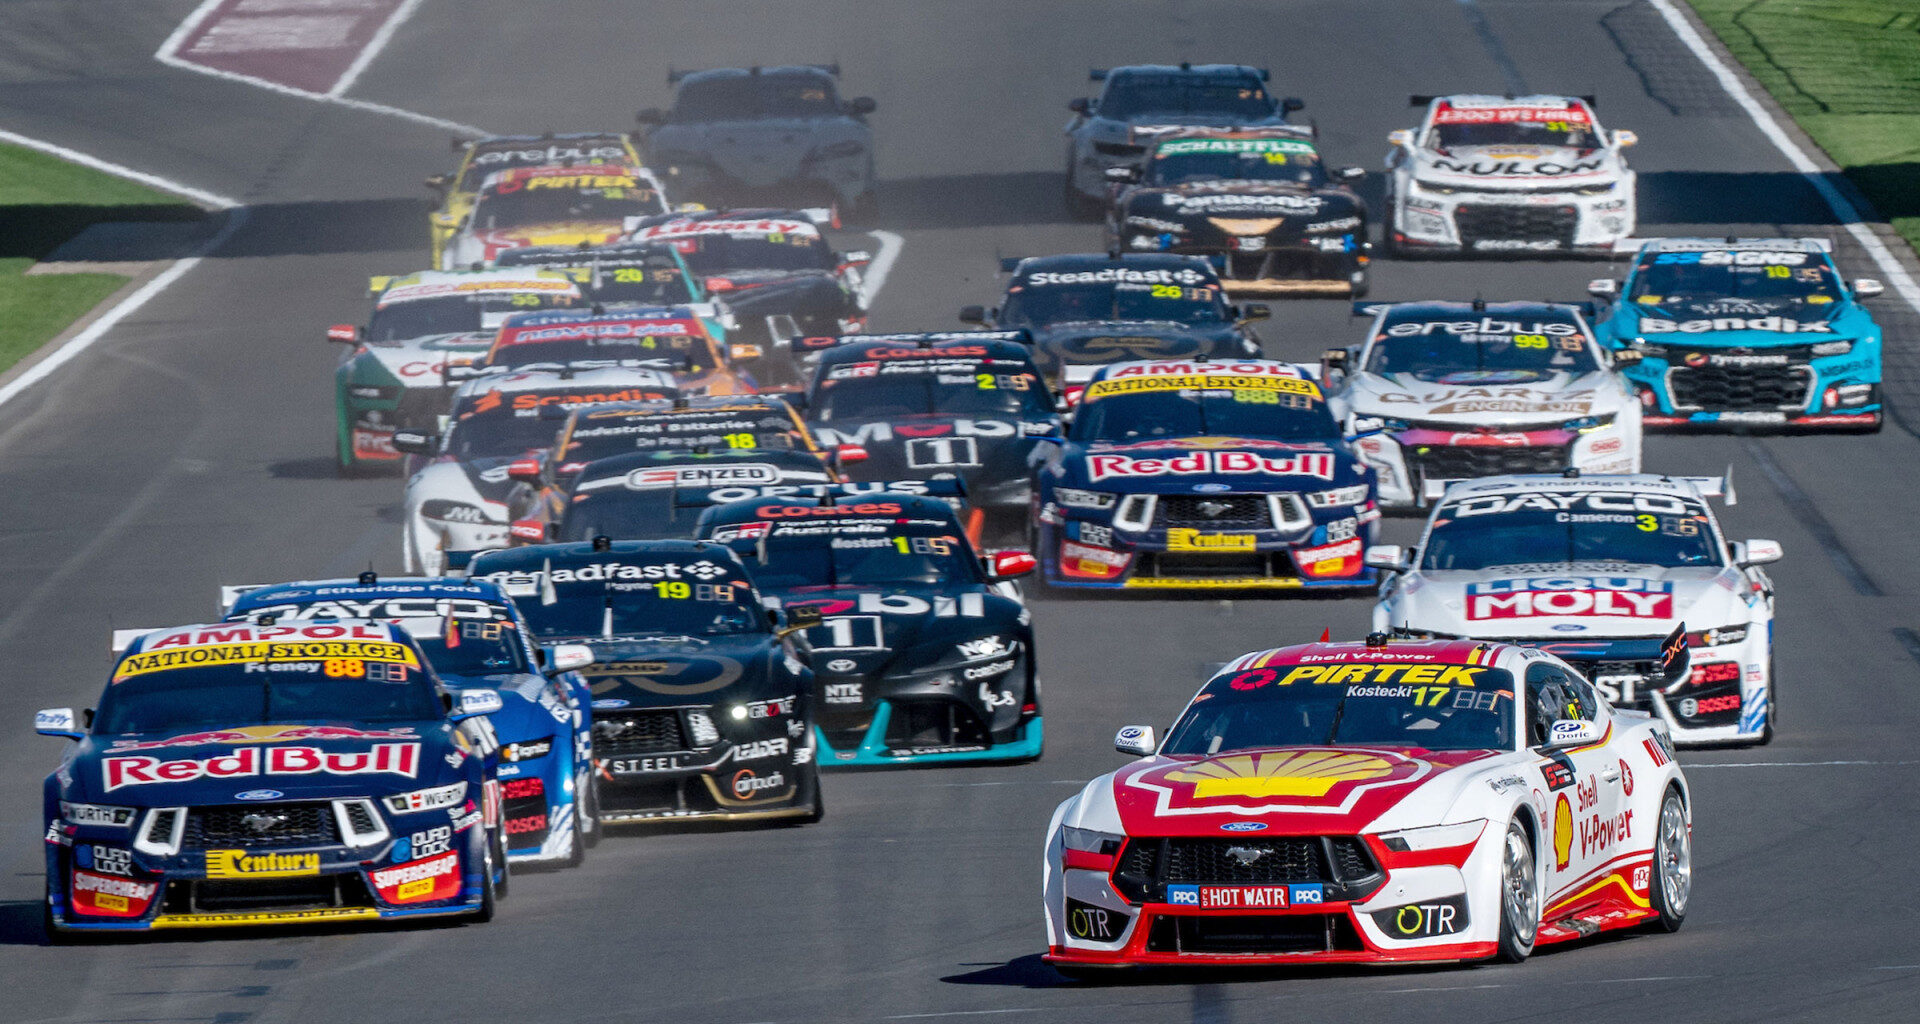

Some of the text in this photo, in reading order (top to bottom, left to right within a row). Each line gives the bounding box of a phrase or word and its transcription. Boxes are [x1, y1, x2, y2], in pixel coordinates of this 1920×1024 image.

[1431, 159, 1604, 176] NULON
[1162, 192, 1323, 208] Panasonic
[1029, 268, 1173, 286] Steadfast
[1763, 265, 1792, 279] 10
[1151, 283, 1182, 299] 26
[1387, 317, 1577, 336] erebus
[1640, 316, 1832, 333] Bendix
[1514, 335, 1549, 349] 99
[865, 345, 988, 360] Coates
[1112, 364, 1295, 378] AMPOL
[975, 372, 997, 390] 2
[1095, 377, 1200, 394] NATIONAL
[1207, 377, 1312, 394] STORAGE
[722, 432, 757, 450] 18
[682, 468, 765, 481] ENZED
[1087, 450, 1336, 483] Red Bull
[1628, 480, 1676, 490] Ford
[755, 502, 903, 518] Coates
[1555, 511, 1636, 524] Cameron
[772, 523, 888, 536] Australia
[1635, 514, 1659, 533] 3
[892, 535, 911, 555] 1
[315, 583, 482, 596] Etheridge Ford
[652, 581, 692, 600] 19
[1475, 577, 1664, 592] LIQUI
[1473, 590, 1671, 619] MOLY
[150, 625, 384, 650] AMPOL
[124, 641, 406, 674] NATIONAL STORAGE
[1299, 652, 1436, 663] Shell V-Power
[244, 660, 322, 675] Feeney
[323, 658, 366, 679] 88
[1277, 664, 1489, 687] PIRTEK
[824, 683, 863, 697] NTK
[1346, 685, 1413, 698] Kostecki
[1412, 686, 1451, 707] 17
[1556, 731, 1590, 741] Doric
[102, 742, 421, 793] Red Bull
[1577, 773, 1599, 813] Shell
[1229, 822, 1260, 831] Ford
[1579, 808, 1634, 861] V-Power
[411, 838, 452, 860] LOCK
[93, 859, 134, 877] LOCK
[231, 850, 319, 871] Century
[373, 854, 458, 889] SUPERCHEAP
[1209, 887, 1286, 907] HOT WATR
[1396, 904, 1457, 936] OTR
